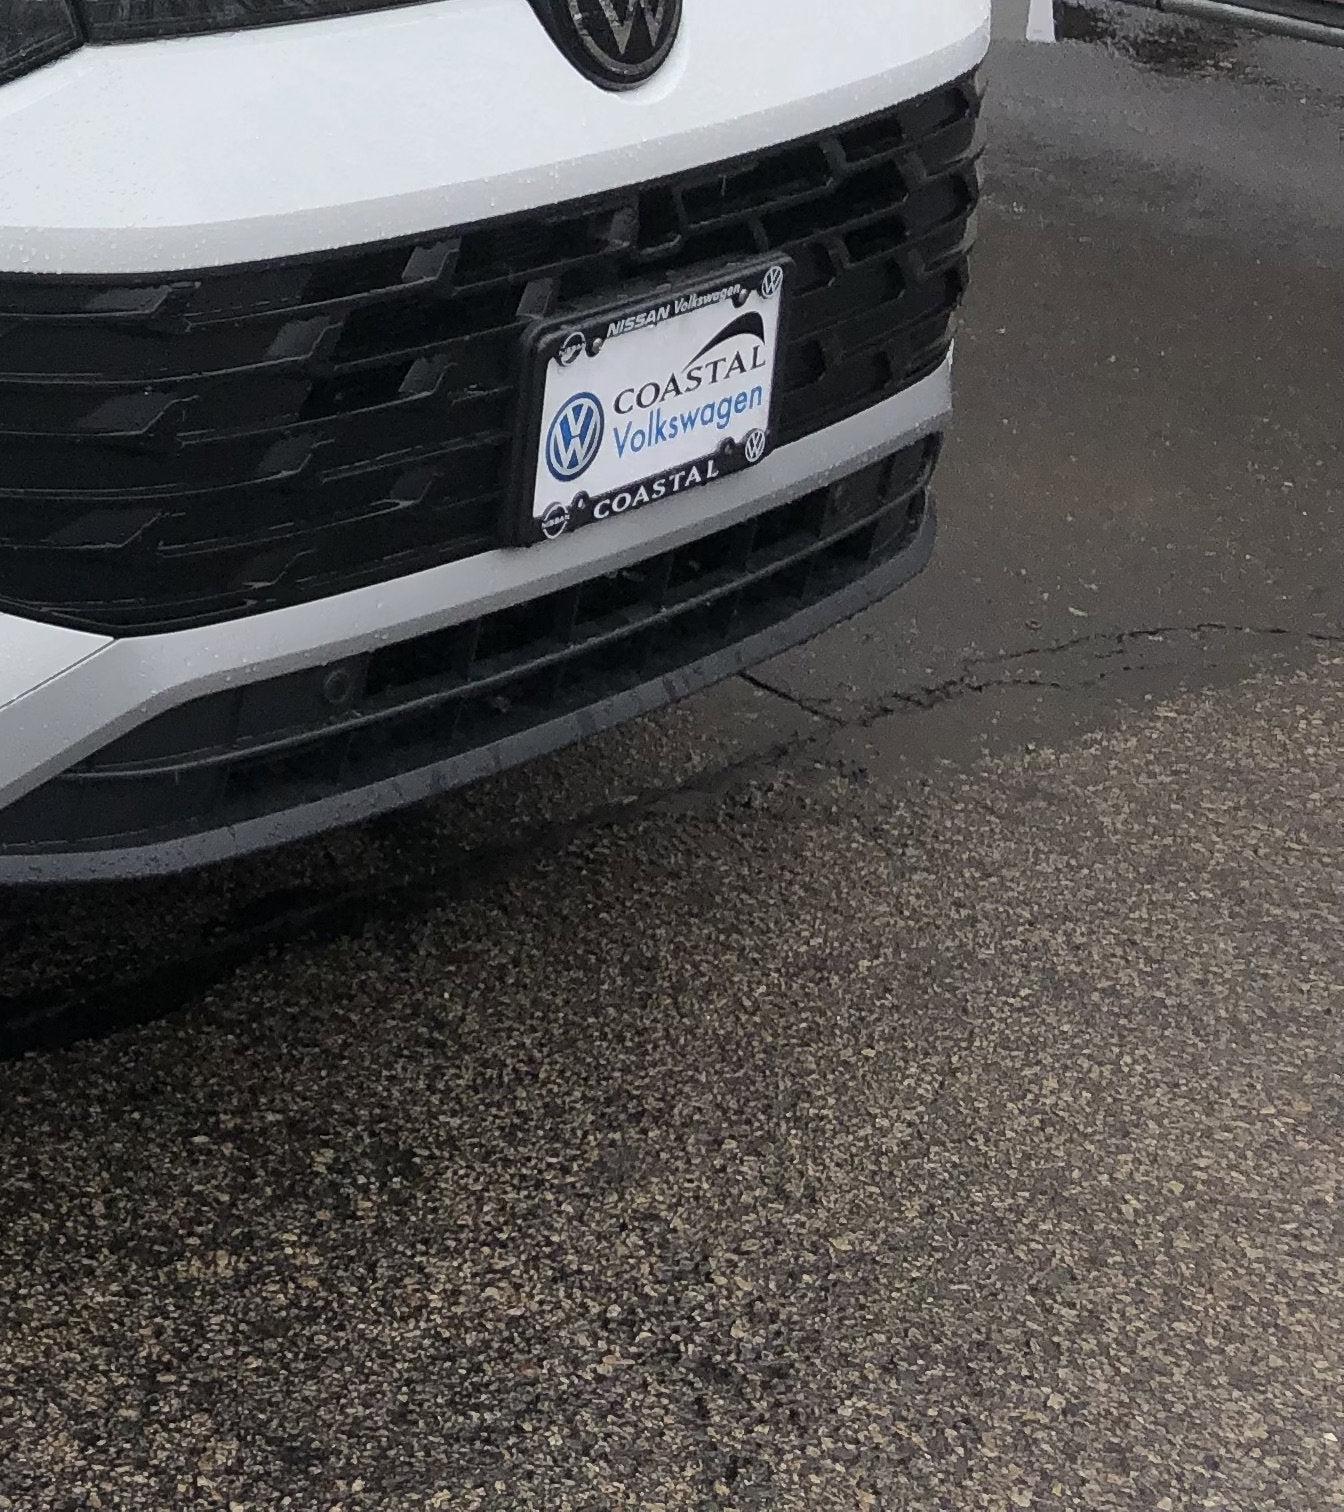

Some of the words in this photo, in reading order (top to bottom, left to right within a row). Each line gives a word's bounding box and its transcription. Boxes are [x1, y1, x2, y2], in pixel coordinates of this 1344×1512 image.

[606, 303, 671, 338] NISSAN
[674, 283, 741, 315] Volkswagen
[612, 344, 766, 415] COASTAL
[612, 384, 763, 459] Volkswagen
[593, 459, 719, 520] COASTAL
